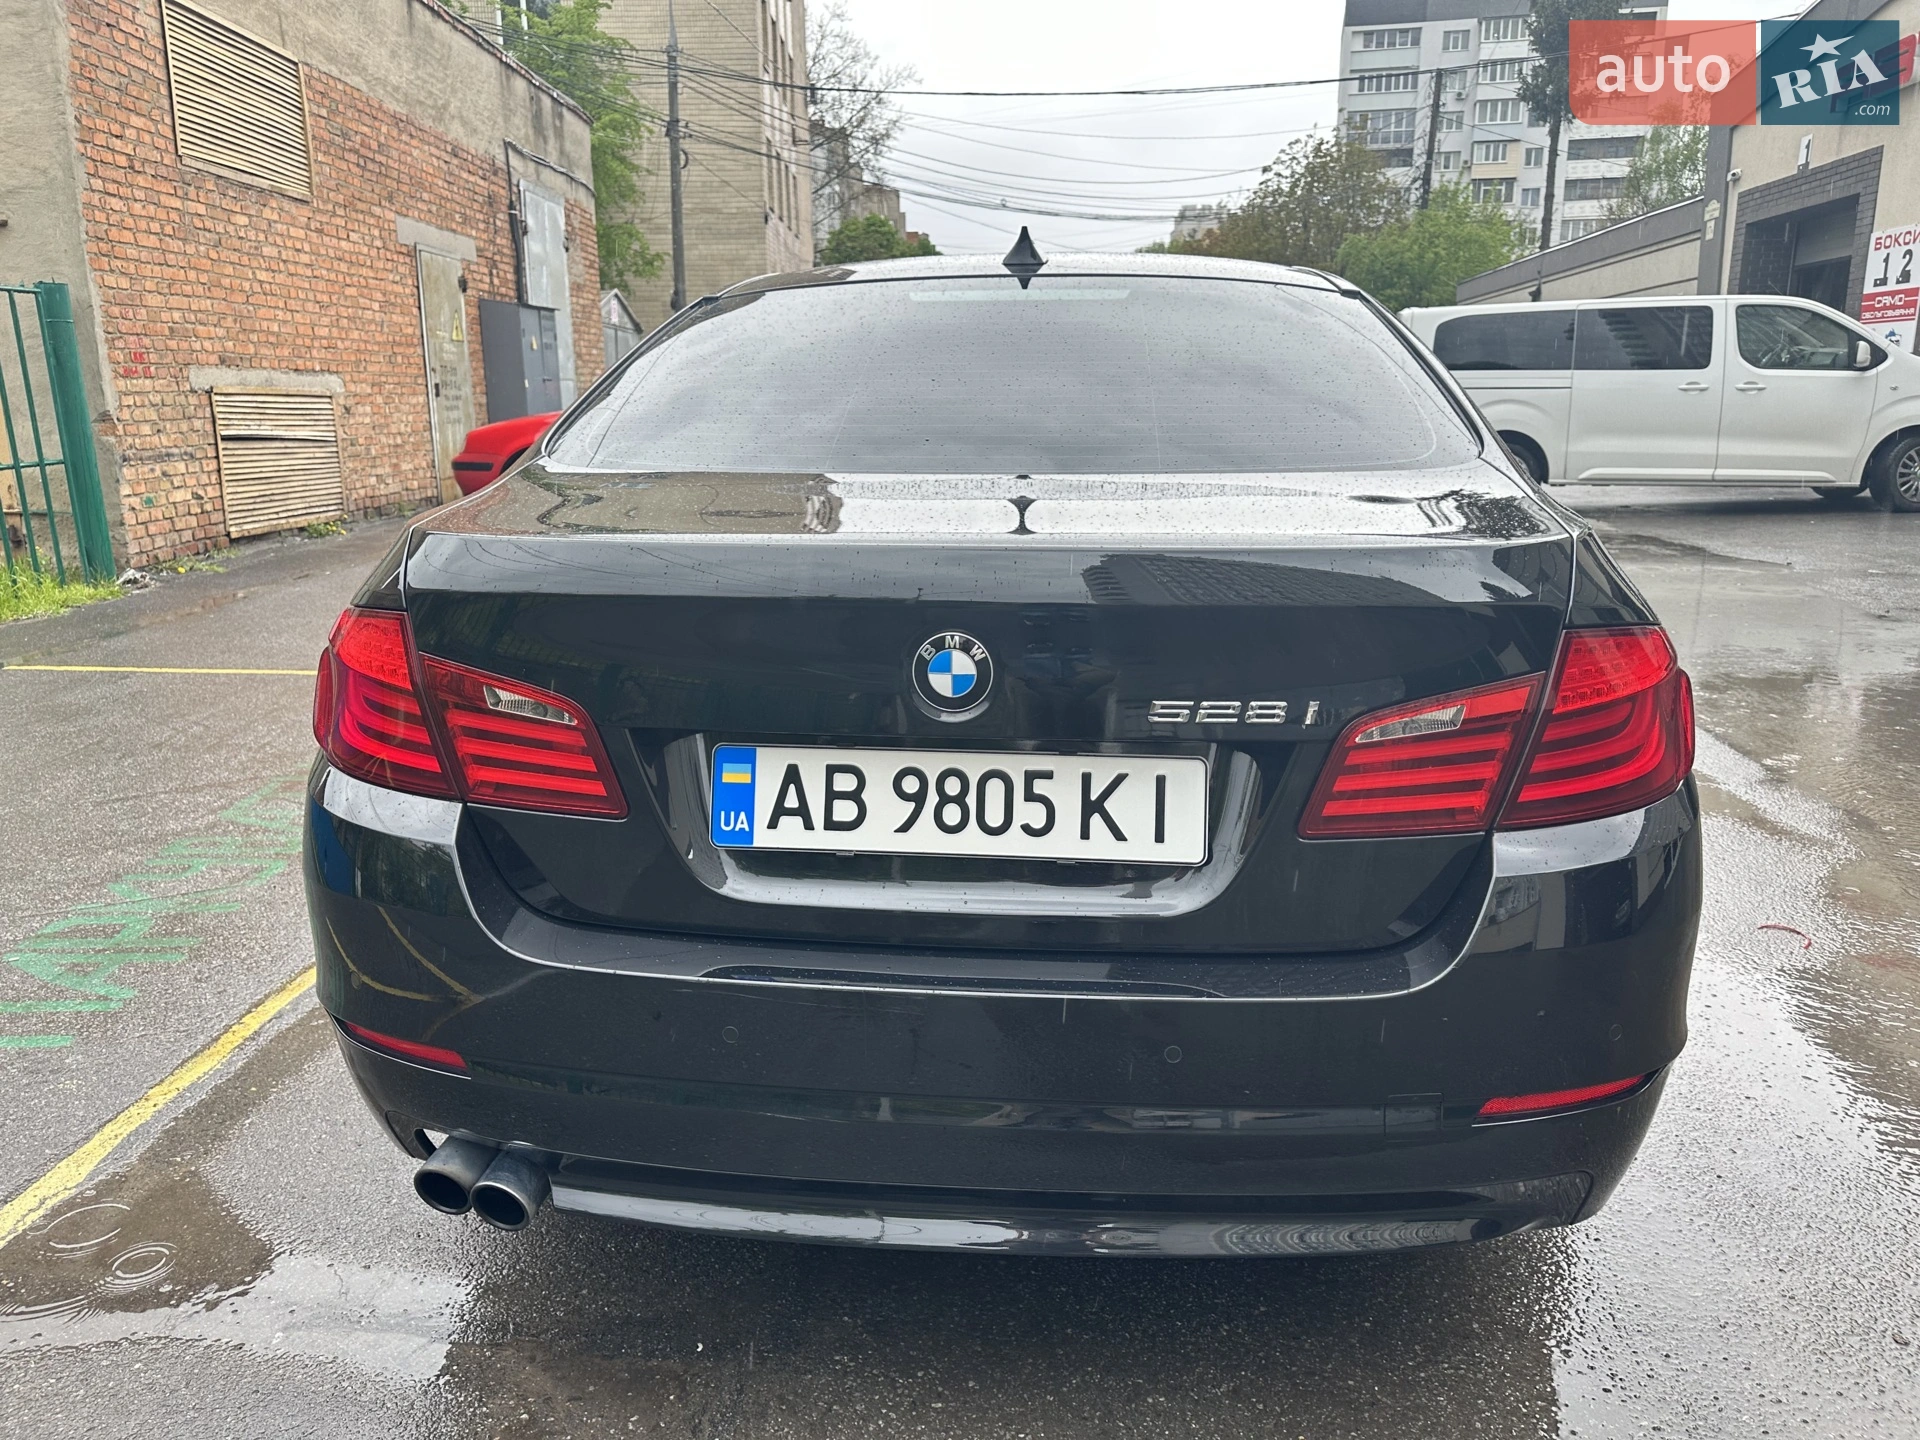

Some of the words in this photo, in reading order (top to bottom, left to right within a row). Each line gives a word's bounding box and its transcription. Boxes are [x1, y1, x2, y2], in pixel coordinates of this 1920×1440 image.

[1873, 252, 1891, 288] 1
[1895, 248, 1914, 285] 2
[1874, 294, 1905, 308] САМО
[920, 635, 987, 662] BMW
[766, 762, 868, 832] AB
[892, 765, 1056, 838] 9805
[1079, 771, 1168, 844] KI
[719, 809, 750, 833] UA
